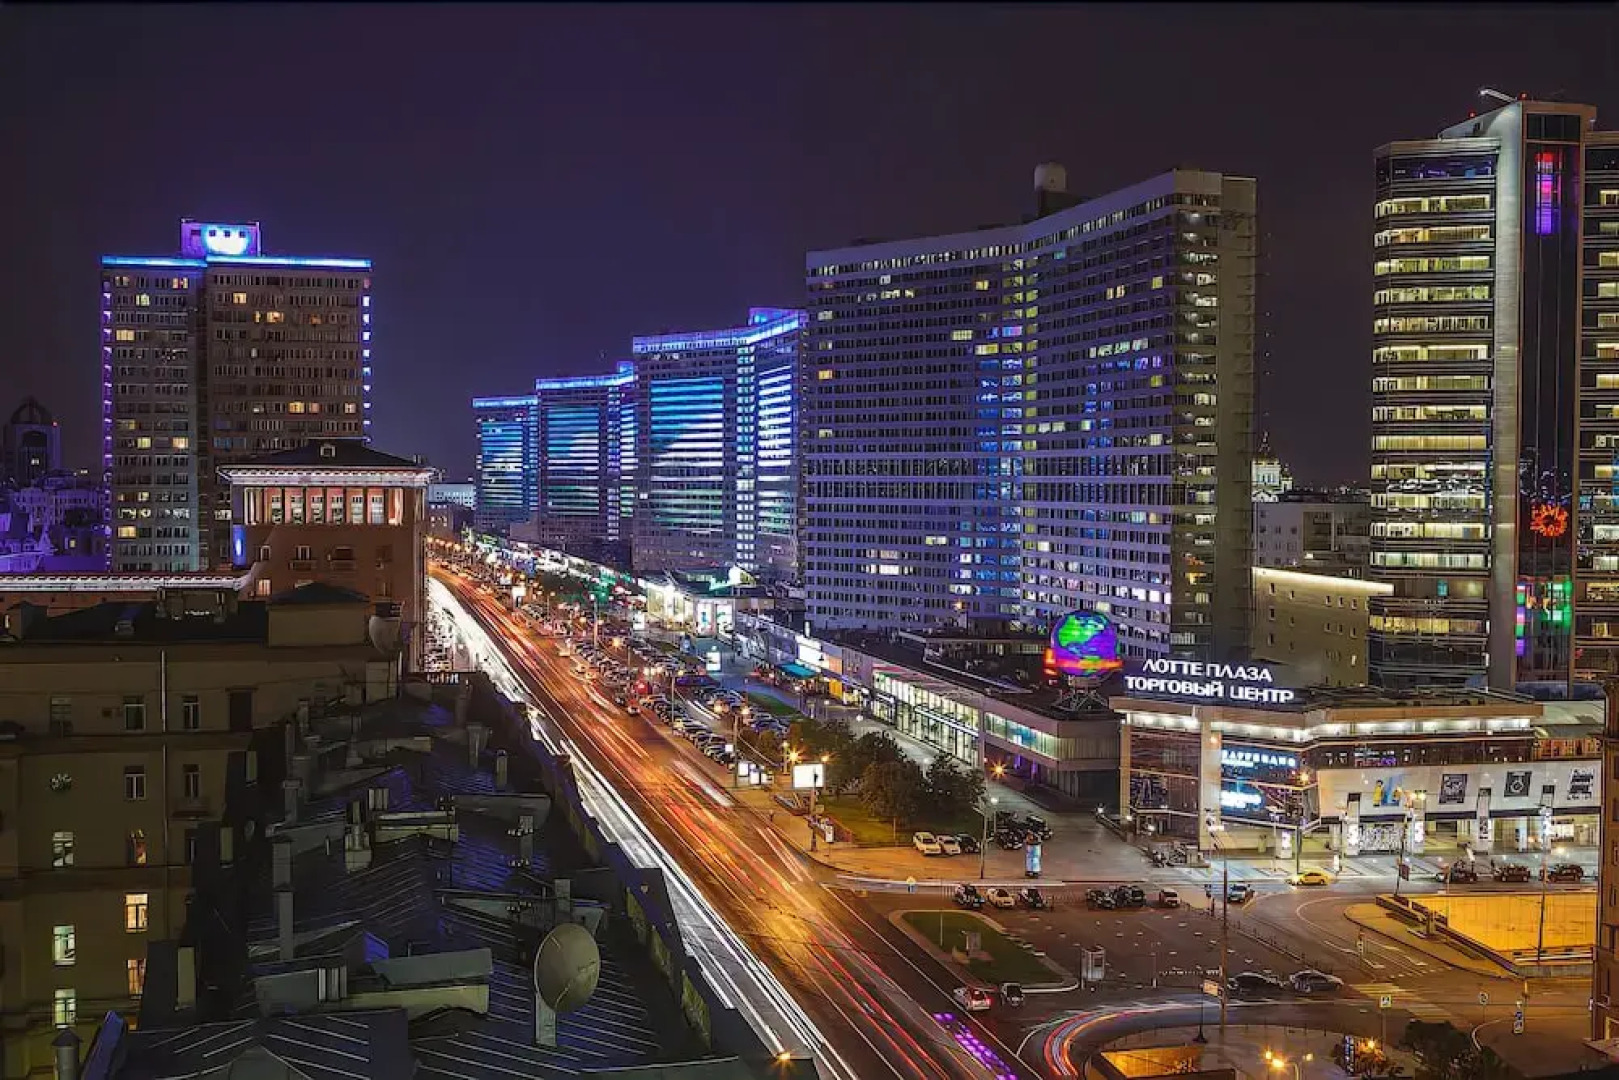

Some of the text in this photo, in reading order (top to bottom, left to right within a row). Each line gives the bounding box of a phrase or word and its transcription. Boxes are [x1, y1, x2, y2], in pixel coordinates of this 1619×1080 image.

[1142, 658, 1203, 677] ЛОТТЕ
[1206, 663, 1273, 683] ПЛАЗА
[1124, 676, 1295, 704] ТОРГОВЫЙ ЦЕНТР
